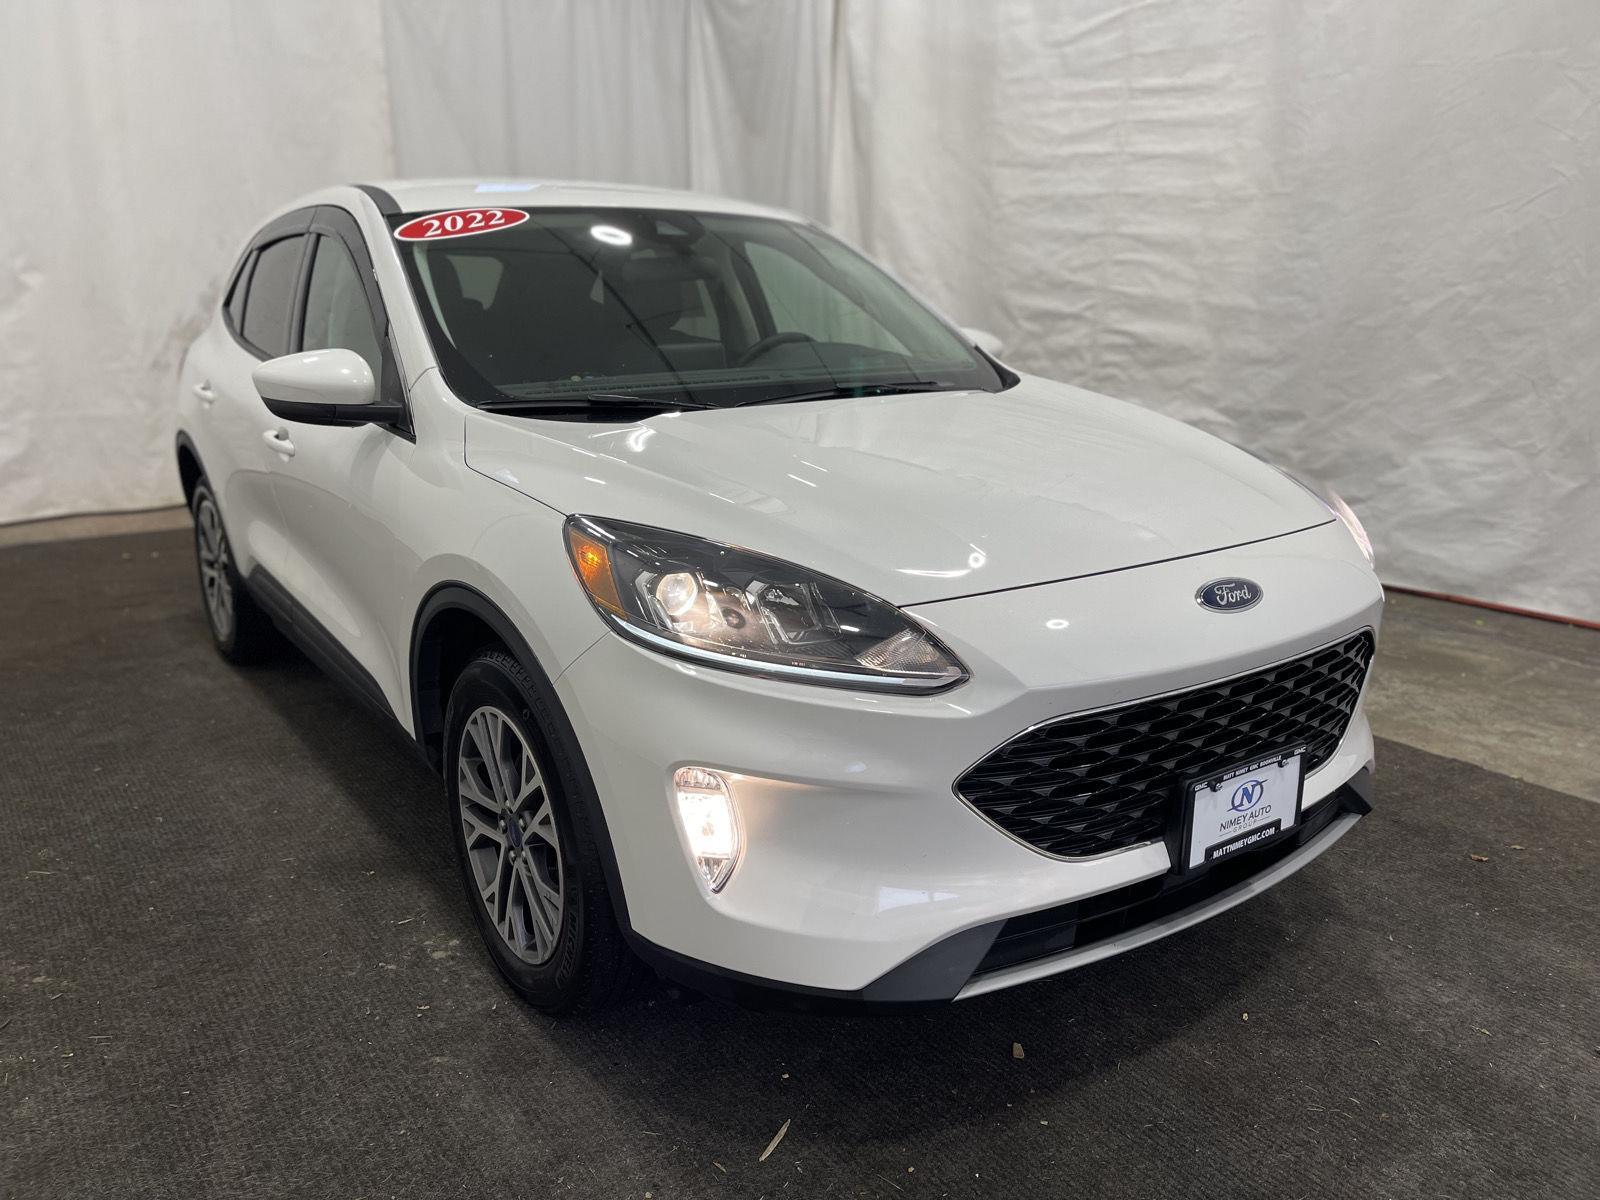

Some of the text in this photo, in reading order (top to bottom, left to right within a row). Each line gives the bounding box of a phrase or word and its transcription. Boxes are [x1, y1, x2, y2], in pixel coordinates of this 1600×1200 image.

[422, 210, 505, 237] 2022
[1214, 583, 1252, 606] Ford
[1294, 747, 1307, 756] GMC
[1194, 781, 1208, 791] GMC
[1219, 804, 1271, 832] NIMEY AUTO
[1232, 819, 1257, 833] GROUP
[1212, 827, 1275, 859] MATTNIMEYGMC.COM
